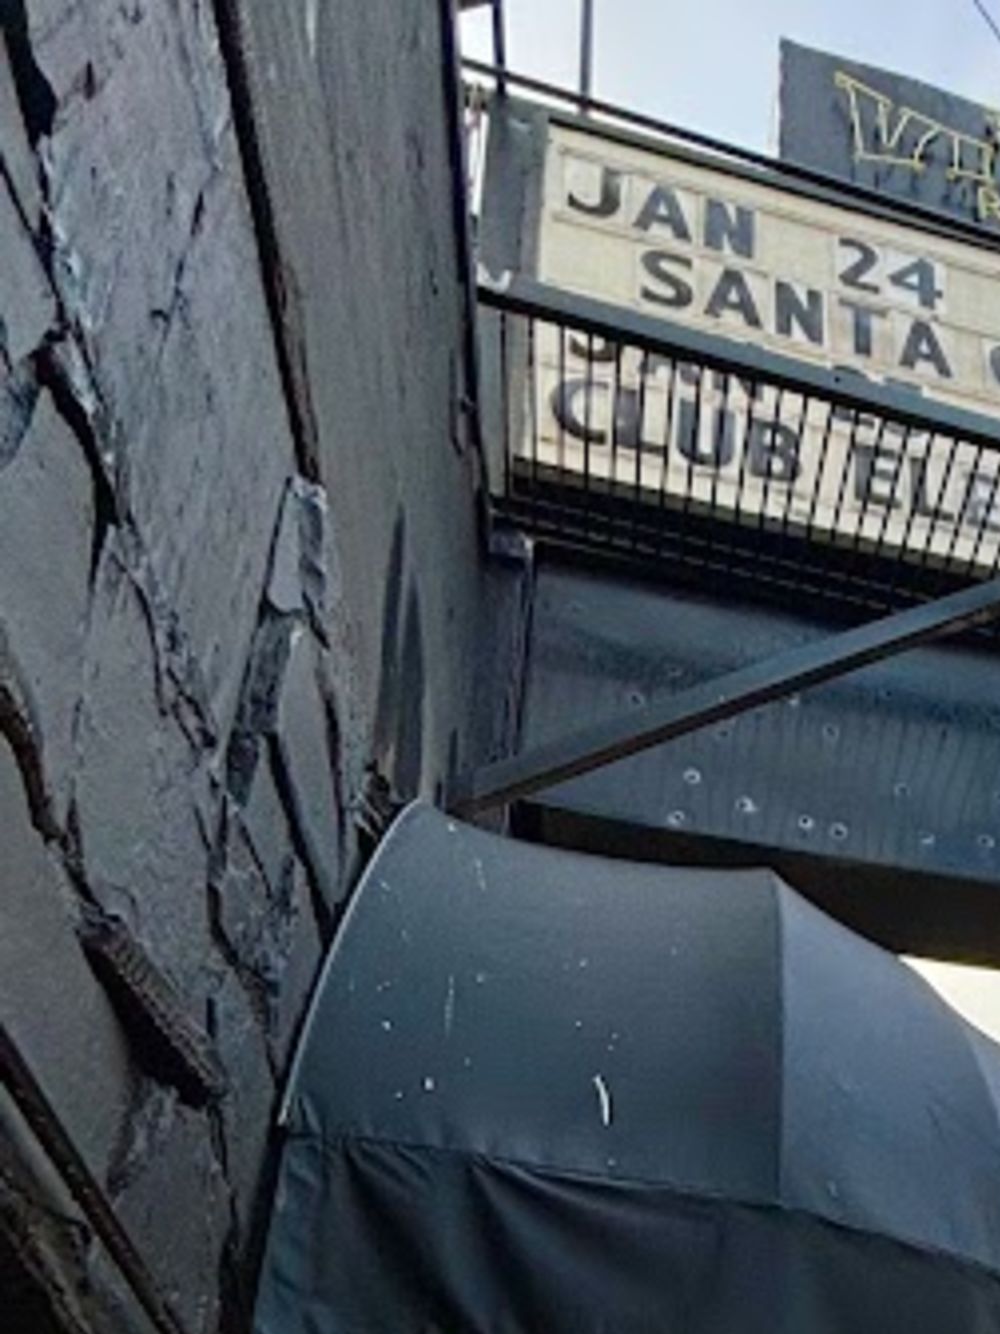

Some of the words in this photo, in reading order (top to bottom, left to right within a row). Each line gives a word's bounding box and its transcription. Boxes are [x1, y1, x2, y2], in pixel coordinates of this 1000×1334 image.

[567, 167, 757, 259] JAN
[838, 237, 943, 311] 24
[640, 250, 953, 378] SANTA
[551, 377, 801, 482] CLUB
